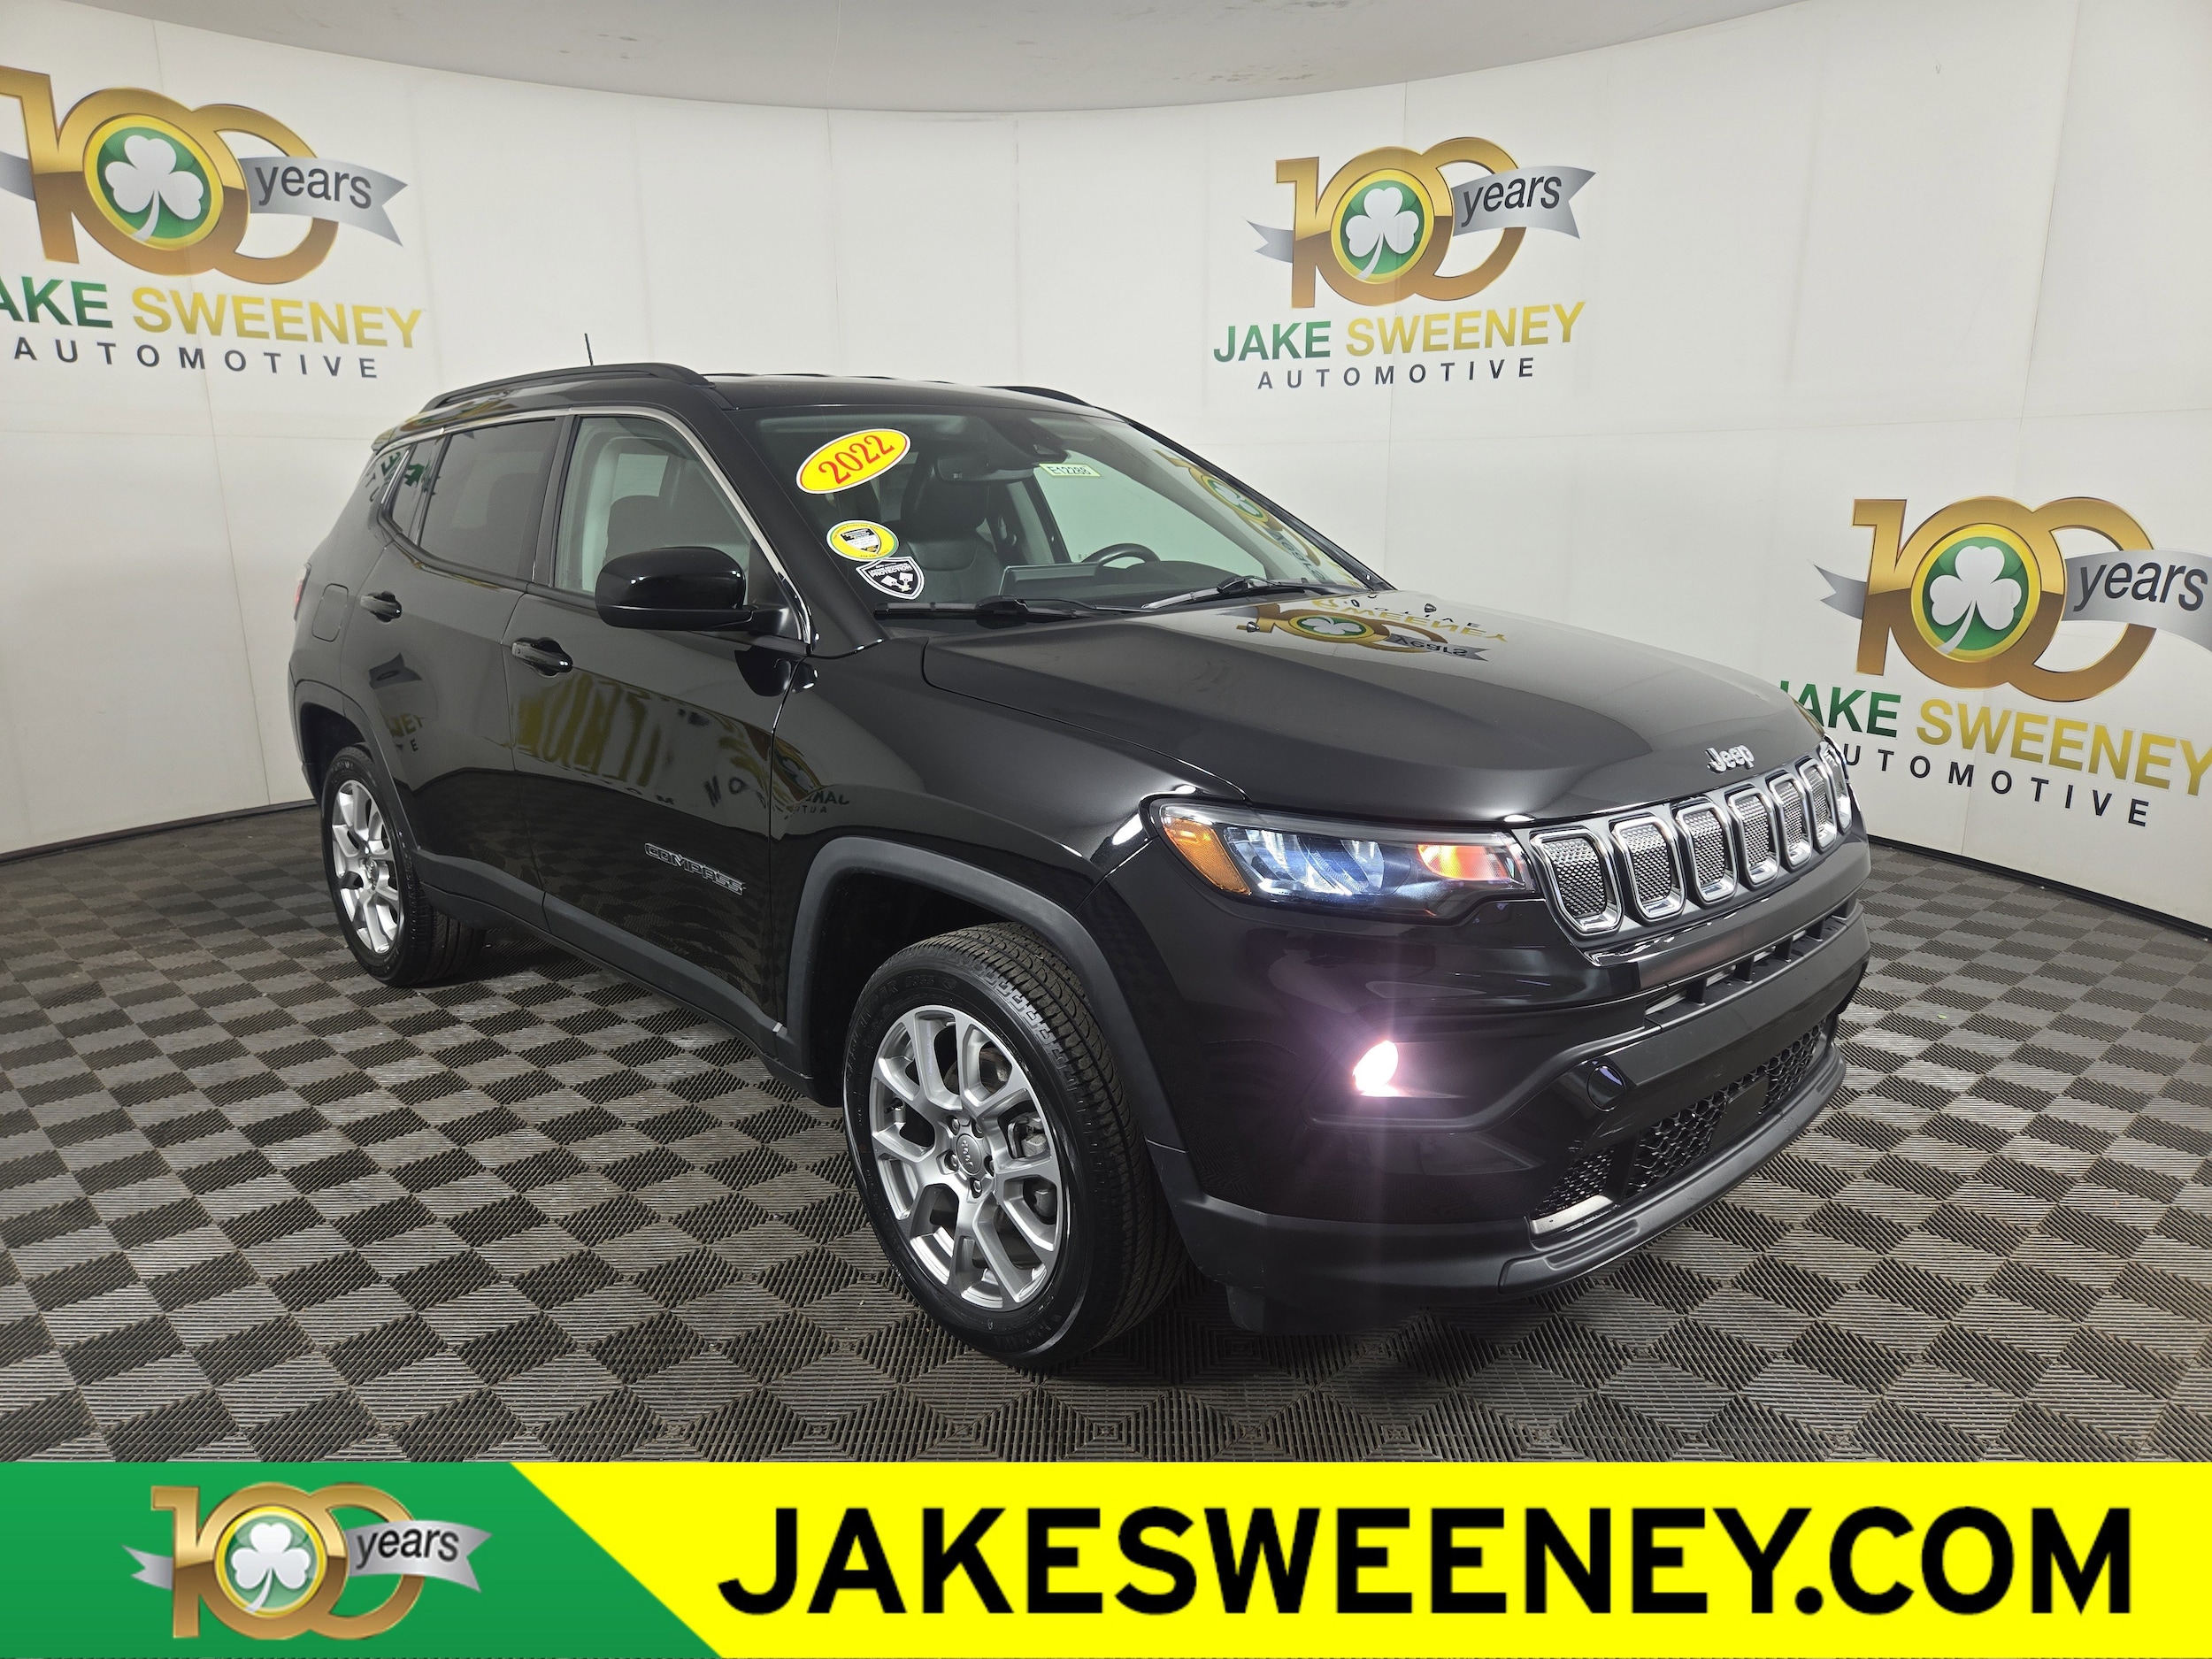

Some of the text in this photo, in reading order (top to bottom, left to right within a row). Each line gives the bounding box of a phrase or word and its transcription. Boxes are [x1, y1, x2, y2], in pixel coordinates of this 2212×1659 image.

[255, 165, 373, 209] years
[1461, 175, 1562, 228] years
[0, 275, 423, 349] AKE SWEENEY
[1213, 302, 1586, 363] JAKE SWEENEY
[13, 336, 378, 379] AUTOMOTIVE
[1257, 357, 1534, 390] AUTOMOTIVE
[818, 434, 894, 484] 2022
[2073, 562, 2208, 612] years
[1705, 745, 1755, 773] Jeep
[1916, 696, 2212, 797] SWEENEY
[1843, 742, 2150, 827] UTOMOTIVE
[644, 842, 747, 895] COMPASS
